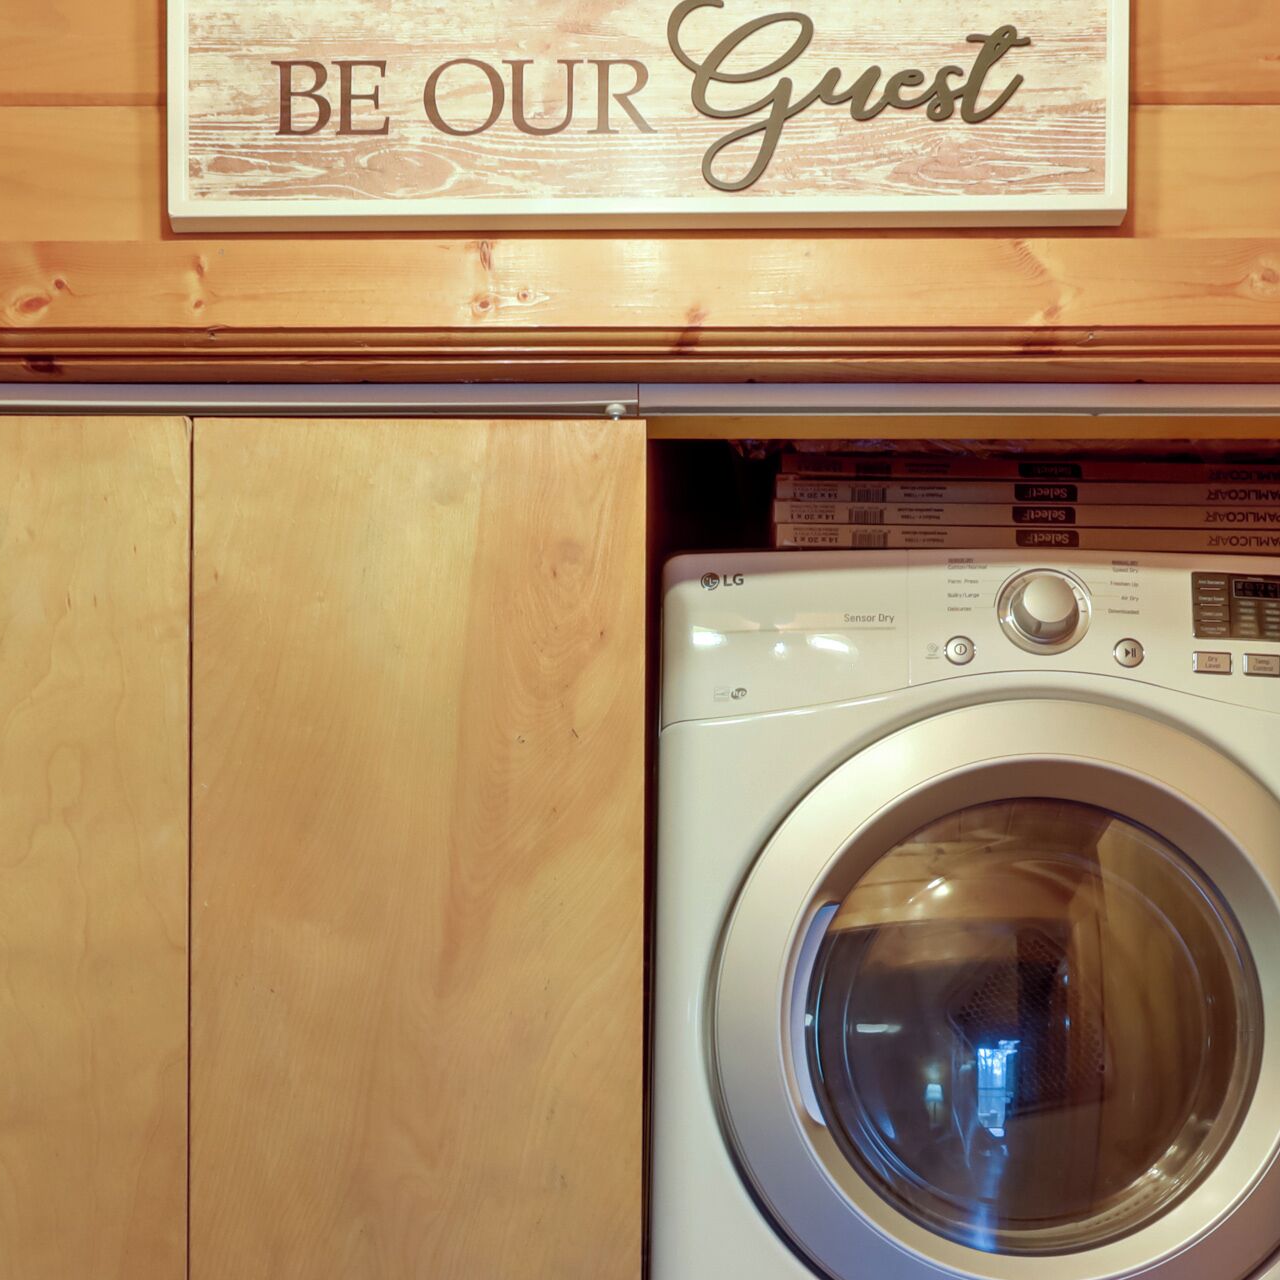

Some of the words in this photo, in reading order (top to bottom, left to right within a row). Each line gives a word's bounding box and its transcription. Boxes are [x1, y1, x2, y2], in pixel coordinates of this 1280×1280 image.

[270, 59, 390, 138] BE
[422, 57, 657, 138] OUR
[665, 0, 1031, 192] Guest
[723, 573, 745, 587] LG
[843, 612, 876, 623] Sensor
[878, 612, 895, 625] Dry
